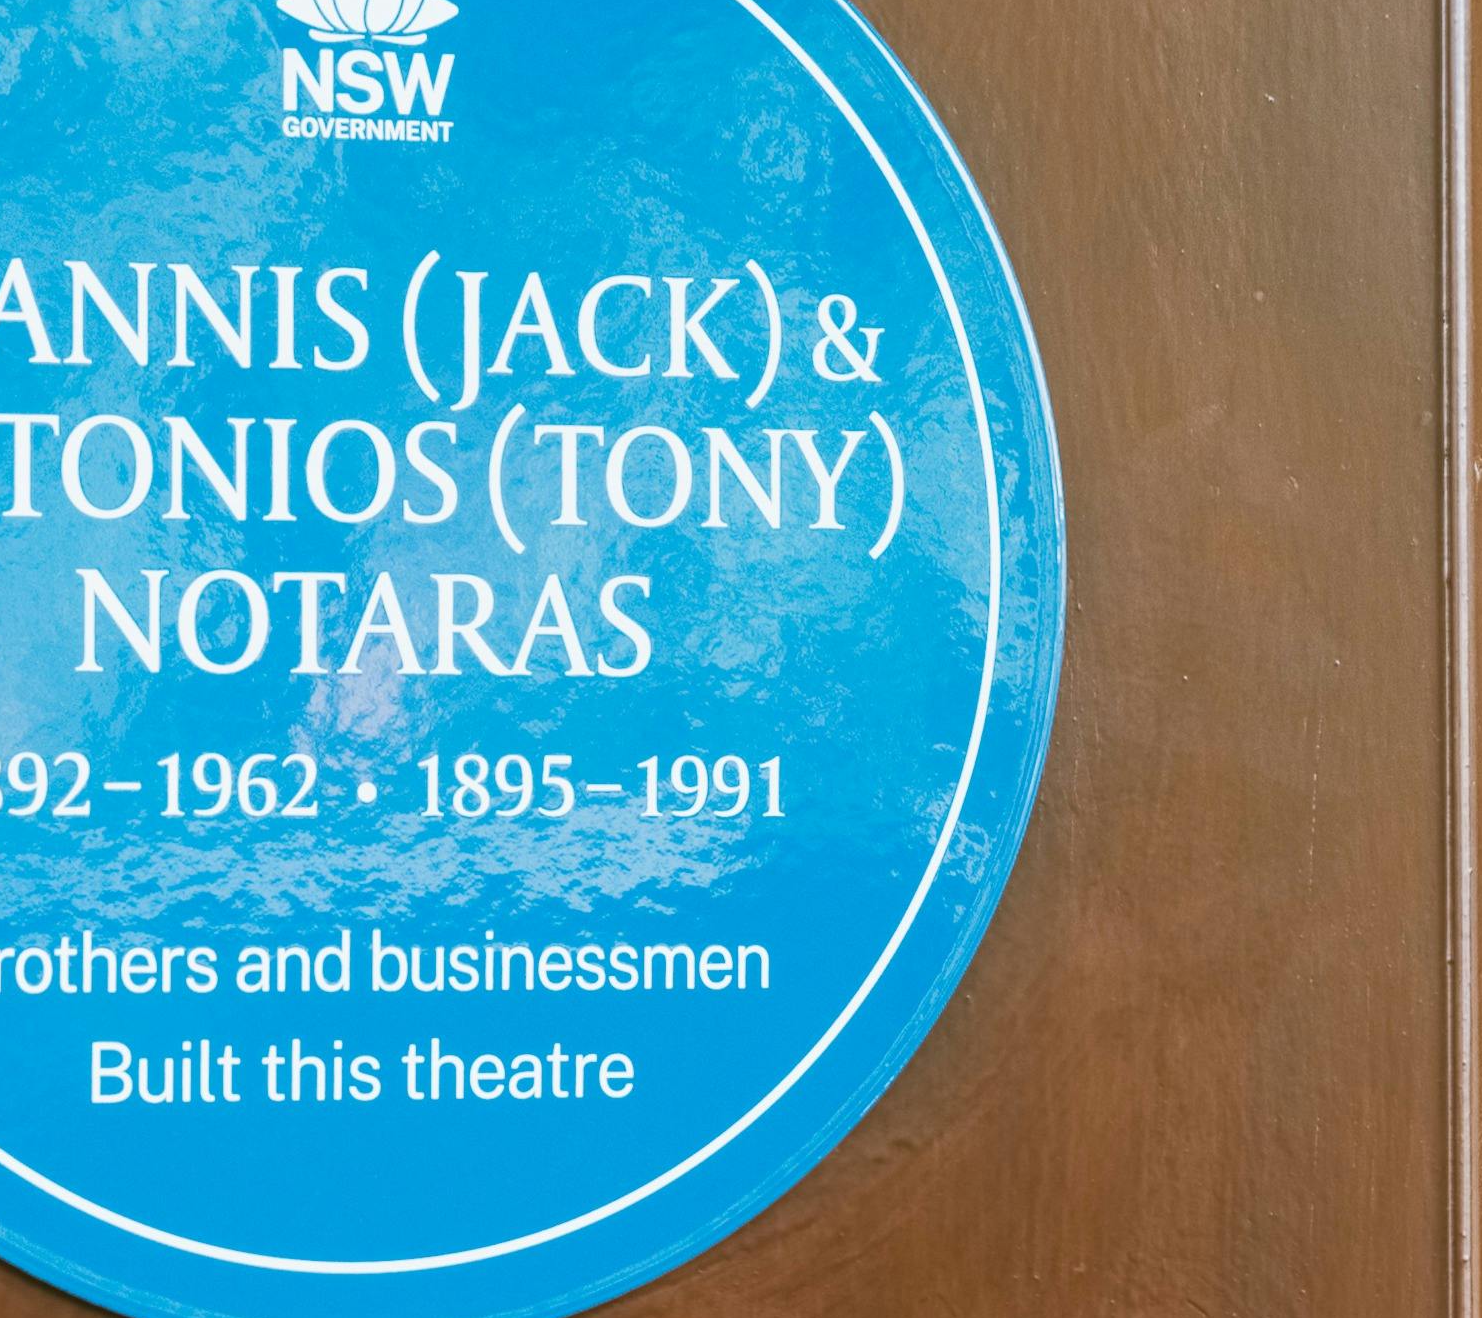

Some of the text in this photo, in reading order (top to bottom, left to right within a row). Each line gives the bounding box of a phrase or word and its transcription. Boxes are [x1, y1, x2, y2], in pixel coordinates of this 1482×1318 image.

[283, 48, 455, 116] NSW
[282, 116, 454, 143] GOVERNMENT
[403, 250, 782, 411] (JACK)
[812, 294, 884, 382] &
[488, 403, 905, 559] (TONY)
[75, 568, 652, 677] NOTARAS
[236, 929, 350, 992] and
[372, 929, 769, 992] businessmen
[91, 1038, 634, 1103] Built this theatre
